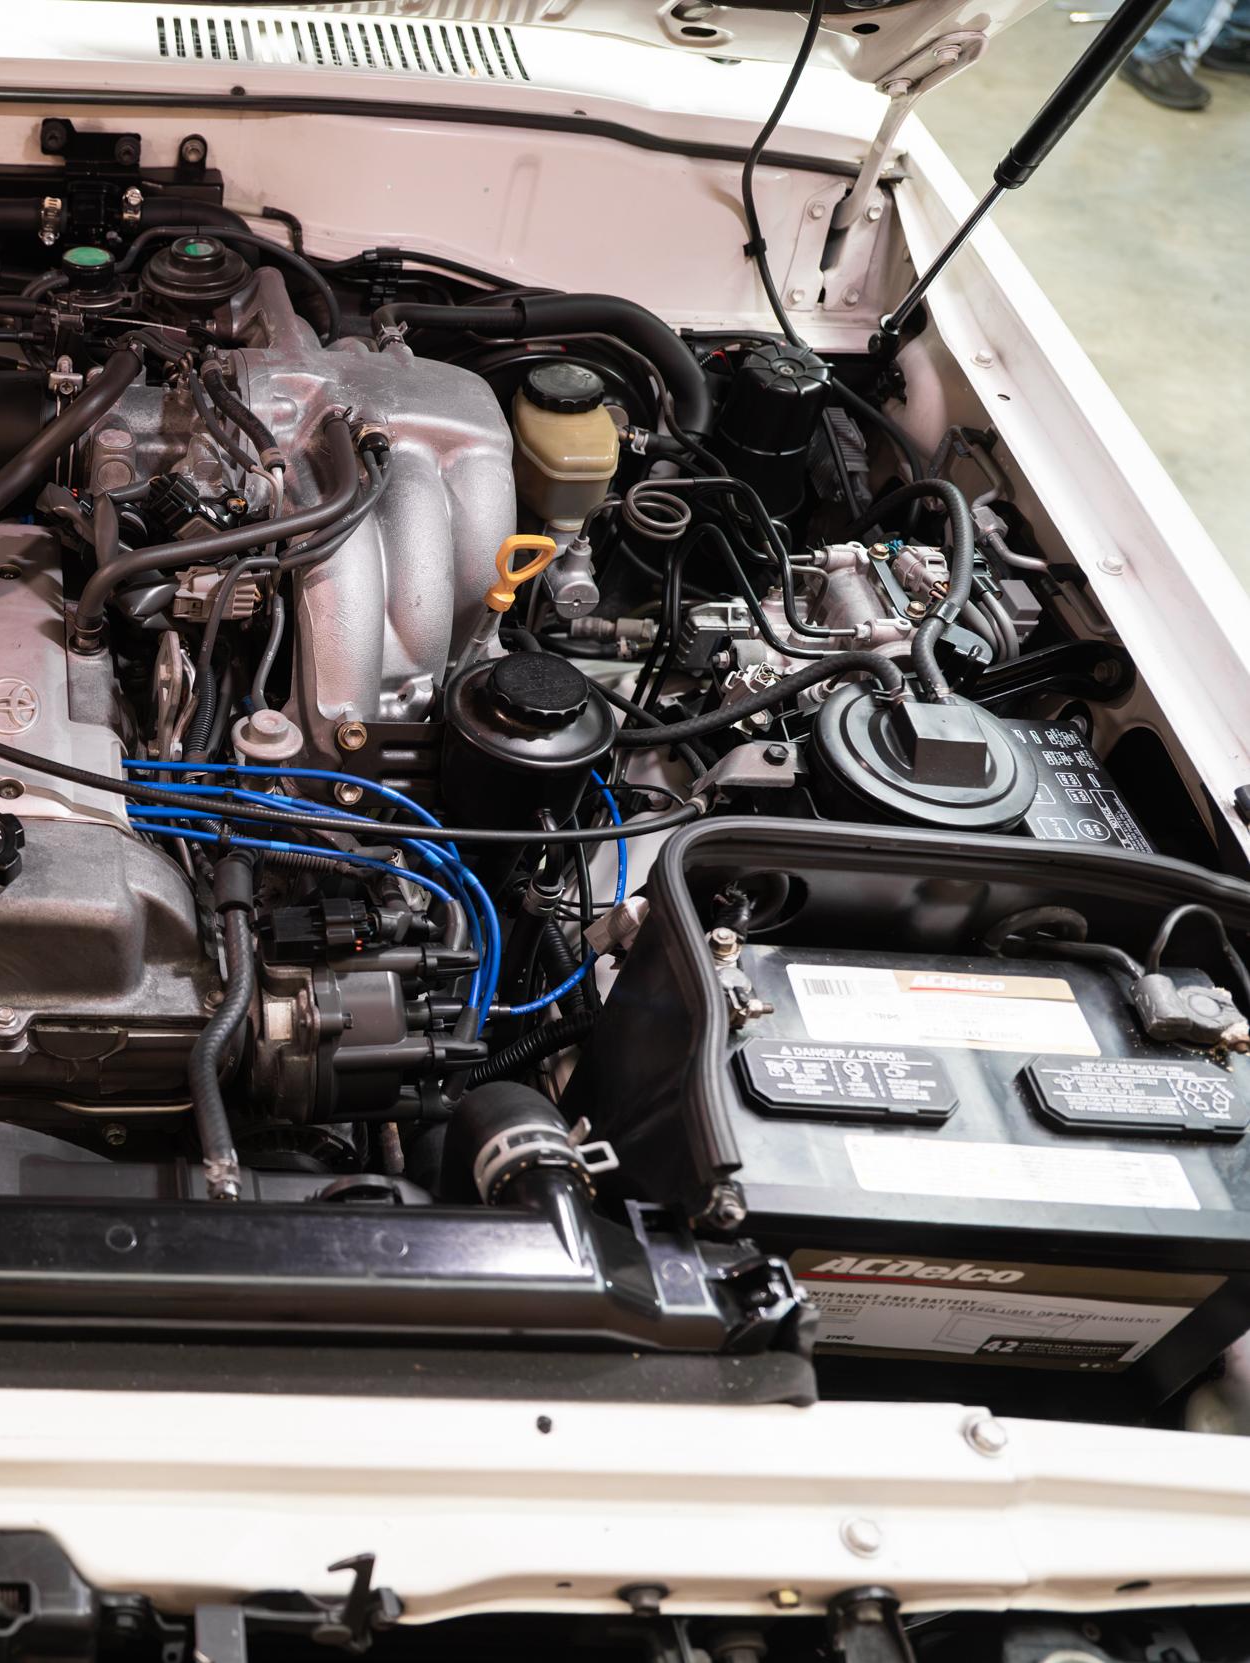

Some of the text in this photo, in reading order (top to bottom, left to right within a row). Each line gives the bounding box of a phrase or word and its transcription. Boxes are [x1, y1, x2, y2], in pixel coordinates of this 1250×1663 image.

[1100, 806, 1122, 829] NOTICE
[1091, 824, 1104, 836] FAN
[909, 974, 1006, 991] ACDelco
[794, 1046, 846, 1059] DANGER
[856, 1050, 907, 1062] POISON
[811, 1255, 1026, 1285] ACDelco
[809, 1290, 979, 1306] NTENANCE FREE BATTERY
[836, 1298, 867, 1306] SANS
[871, 1300, 937, 1310] ENTRETIEN
[982, 1339, 1020, 1353] 42
